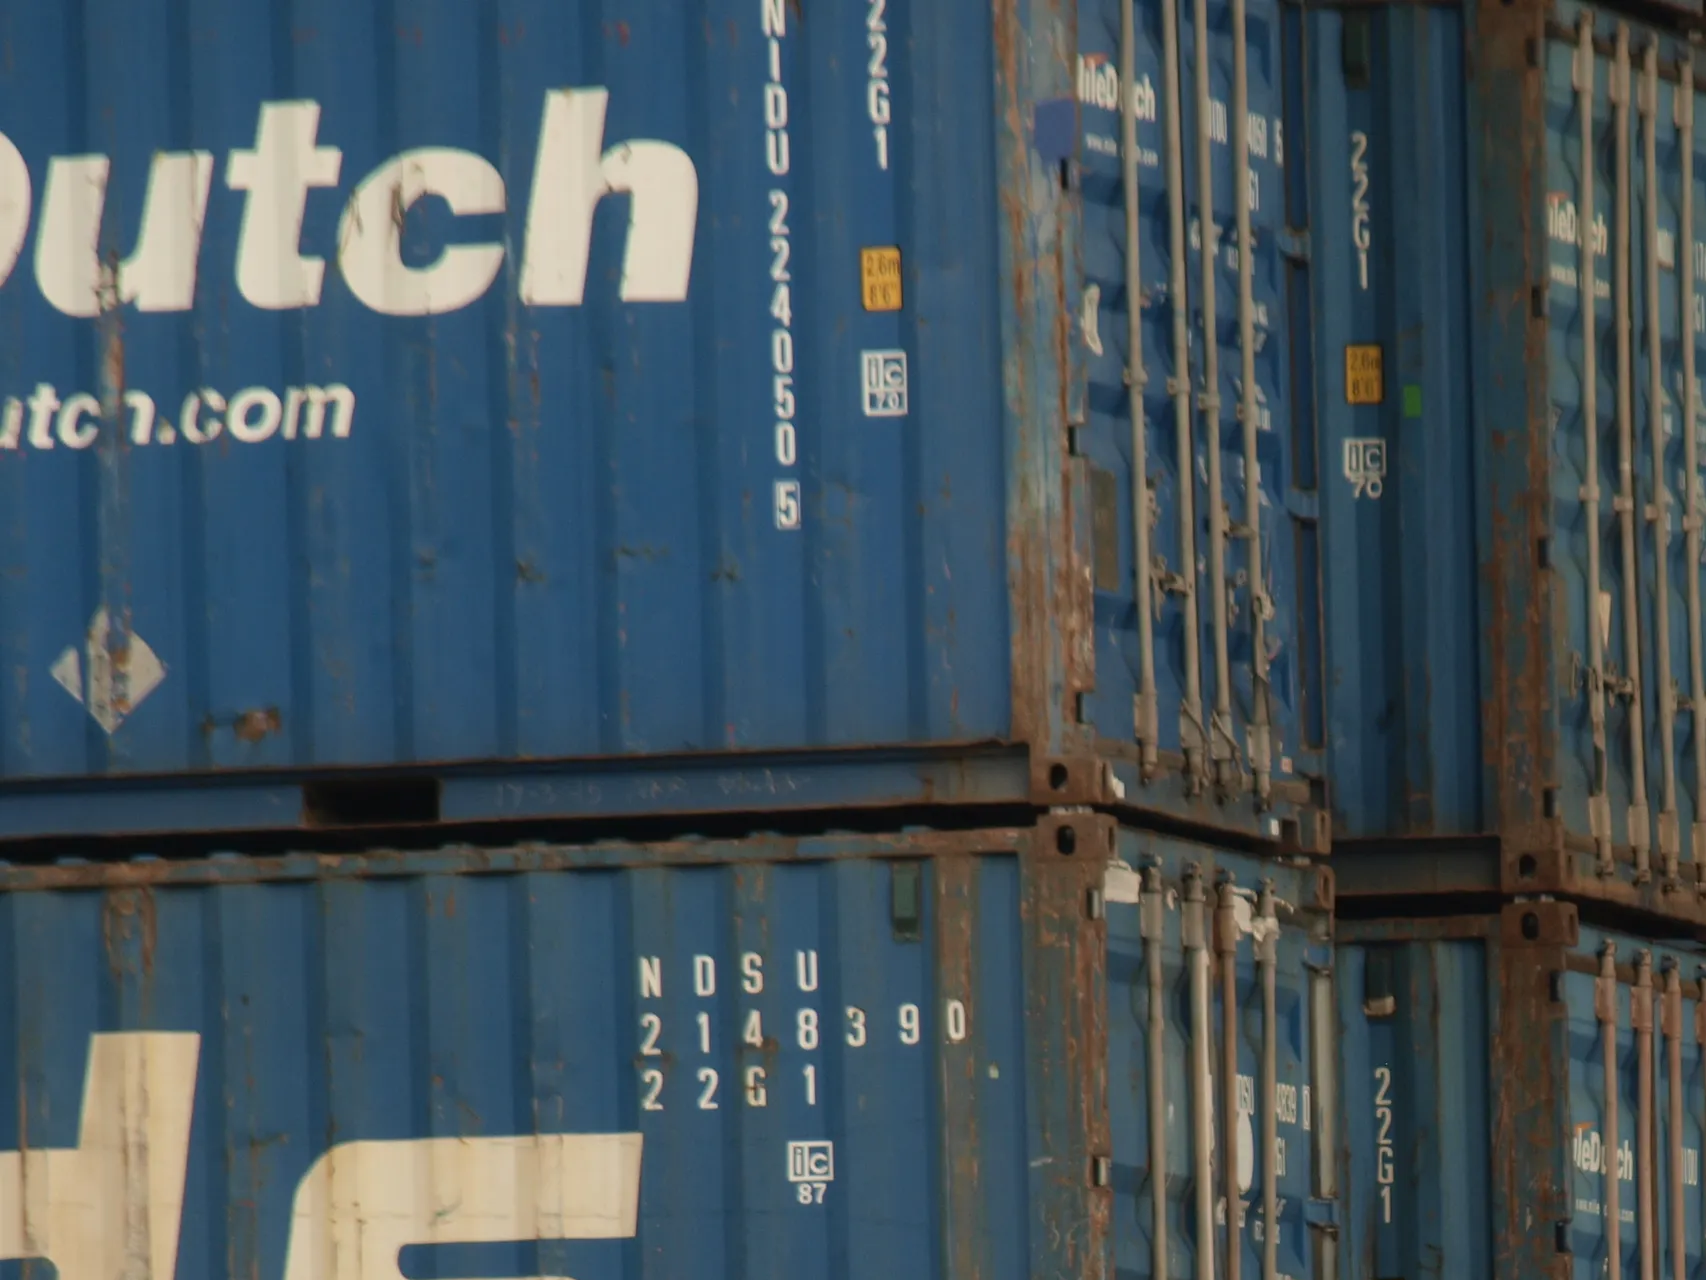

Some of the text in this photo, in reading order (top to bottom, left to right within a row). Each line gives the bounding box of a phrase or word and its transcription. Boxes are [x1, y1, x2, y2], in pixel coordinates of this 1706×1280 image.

[868, 0, 891, 170] 22G1
[0, 86, 699, 318] utch
[761, 0, 799, 527] NIDU 224050 5
[1351, 131, 1370, 290] 22G1
[1351, 478, 1383, 500] 70
[638, 950, 819, 998] NDSU
[641, 1064, 818, 1111] 22G1
[1374, 1065, 1396, 1224] 22G1
[796, 1183, 828, 1205] 87
